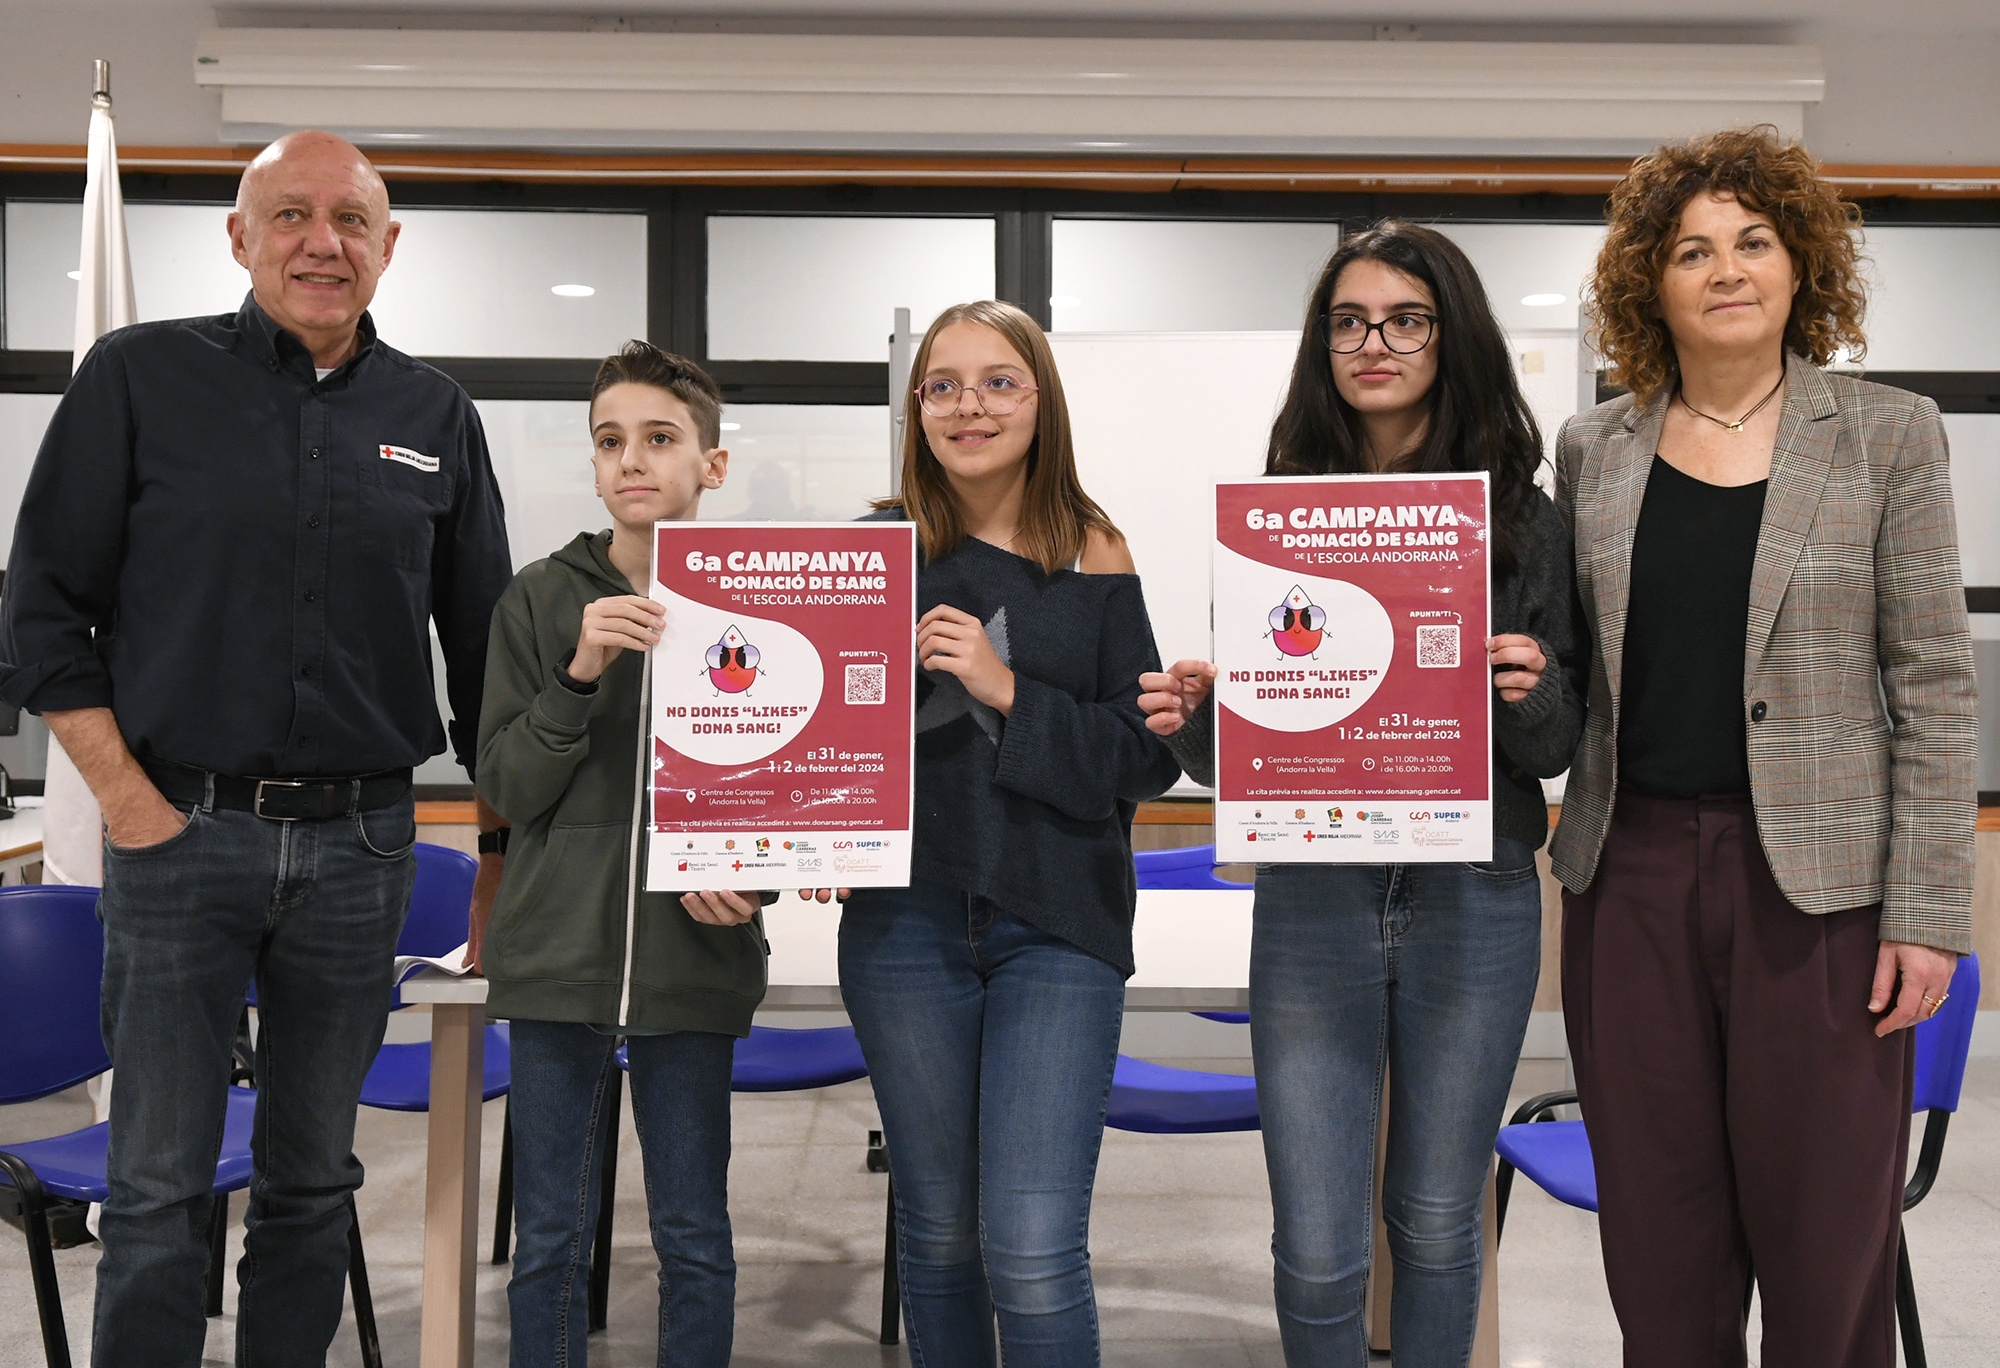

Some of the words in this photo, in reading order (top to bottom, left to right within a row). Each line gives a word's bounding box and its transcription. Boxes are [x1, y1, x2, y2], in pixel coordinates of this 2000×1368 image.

[1246, 508, 1284, 530] 6a
[1289, 505, 1458, 529] CAMPANYA
[1282, 530, 1372, 548] DONACIÓ
[1375, 532, 1401, 547] DE
[1404, 531, 1459, 546] SANG
[685, 551, 721, 572] 6a
[727, 551, 887, 572] CAMPANYA
[1307, 552, 1369, 564] L'ESCOLA
[1372, 551, 1459, 563] ANDORRANA
[720, 573, 806, 590] DONACIÓ
[809, 576, 834, 590] DE
[835, 576, 887, 590] SANG
[743, 594, 803, 605] L'ESCOLA
[805, 594, 887, 605] ANDORRANA
[1229, 671, 1251, 682] NO
[1254, 670, 1305, 682] DONIS
[1309, 669, 1378, 681] "LIKES"
[1256, 688, 1299, 699] DONA
[1303, 687, 1350, 699] SANG!
[666, 706, 687, 718] NO
[690, 706, 739, 717] DONIS
[742, 705, 808, 717] "LIKES"
[1379, 717, 1389, 726] El
[1390, 713, 1408, 726] 31
[1412, 717, 1426, 726] de
[1428, 718, 1460, 728] gener,
[692, 723, 733, 734] DONA
[736, 723, 781, 734] SANG!
[1338, 727, 1345, 740] 1
[1348, 730, 1352, 740] i
[1354, 727, 1364, 740] 2
[1366, 730, 1380, 740] de
[1381, 730, 1413, 740] febrer
[1414, 730, 1431, 739] del
[1433, 730, 1461, 740] 2024
[807, 751, 816, 760] El
[818, 747, 835, 760] 31
[838, 751, 851, 760] de
[853, 752, 884, 762] gener,
[1267, 756, 1291, 764] Centre
[1292, 756, 1301, 764] de
[1303, 756, 1345, 765] Congressos
[768, 761, 775, 773] 1
[777, 764, 781, 773] i
[783, 760, 792, 773] 2
[795, 764, 808, 773] de
[809, 764, 839, 773] febrer
[840, 764, 856, 773] del
[858, 764, 884, 773] 2024
[1276, 766, 1308, 774] (Andorra
[734, 789, 774, 797] Congressos
[1269, 788, 1291, 796] prèvia
[1365, 788, 1461, 796] www.donarsang.gencat.cat
[708, 798, 739, 806] (Andorra
[747, 798, 766, 806] Vella)
[793, 819, 884, 827] www.donarsang.gencat.cat
